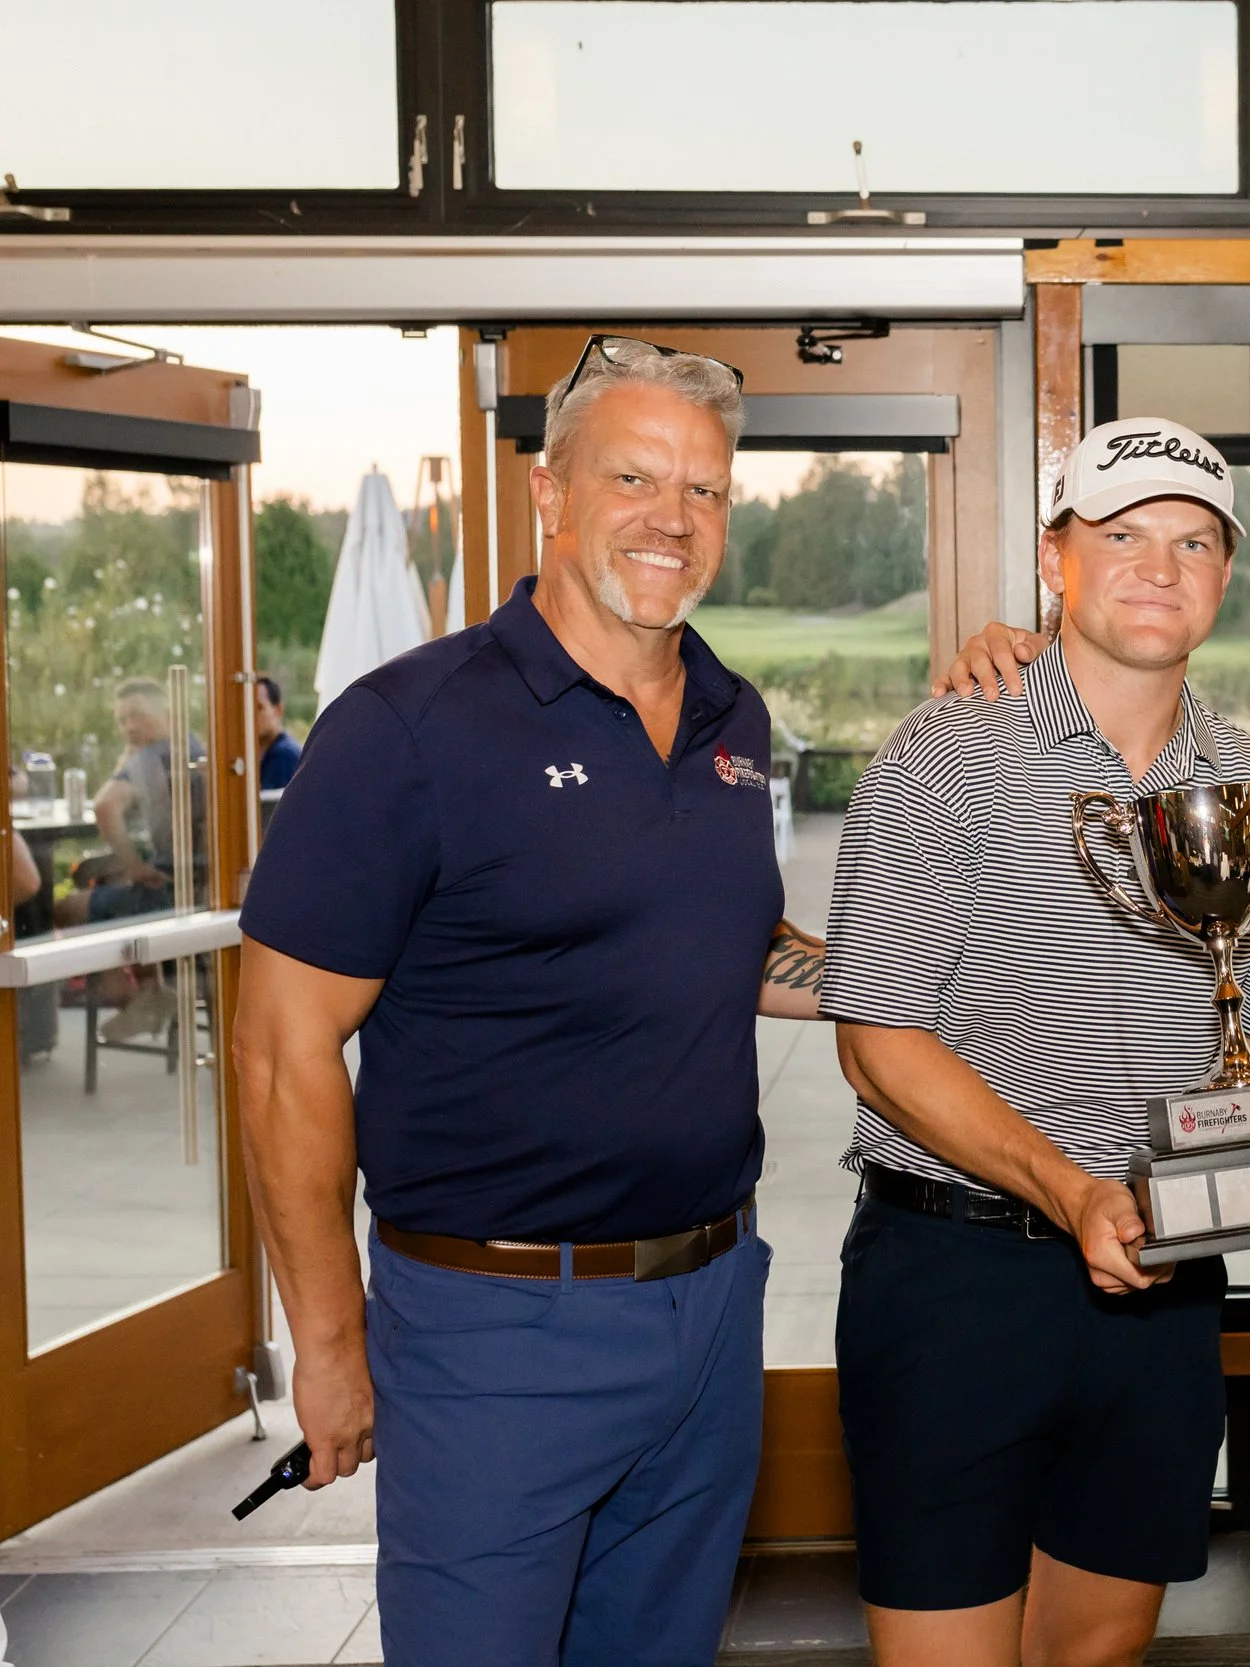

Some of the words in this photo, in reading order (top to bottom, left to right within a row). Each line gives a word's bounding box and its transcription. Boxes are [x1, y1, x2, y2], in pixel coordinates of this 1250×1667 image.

[1096, 431, 1224, 481] Titleist
[1196, 1108, 1228, 1120] BURNABY
[1197, 1114, 1247, 1128] FIREFIGHTERS
